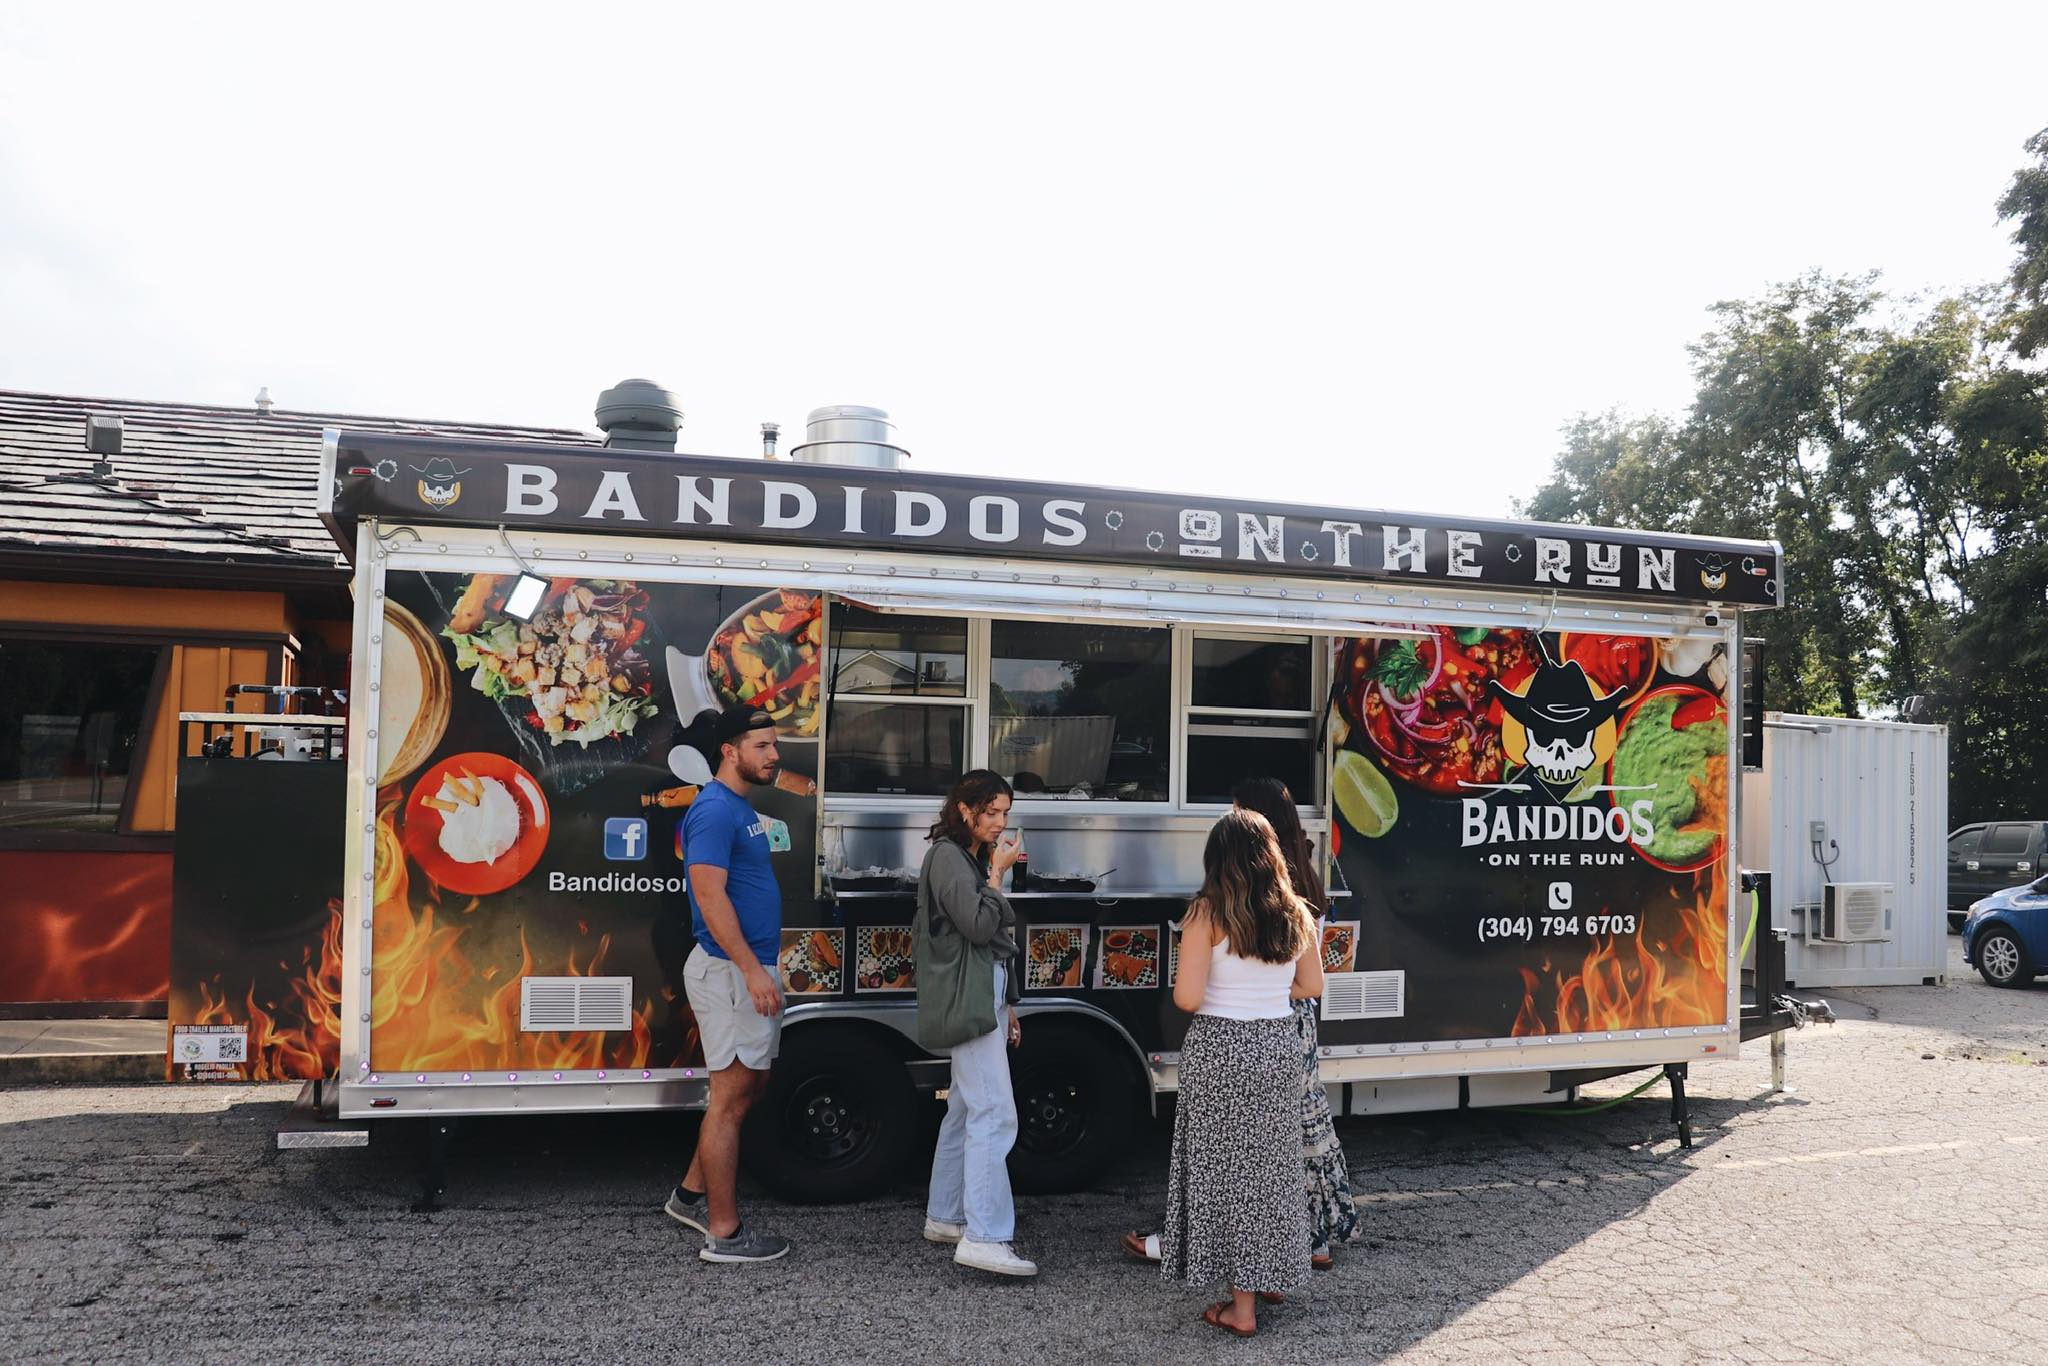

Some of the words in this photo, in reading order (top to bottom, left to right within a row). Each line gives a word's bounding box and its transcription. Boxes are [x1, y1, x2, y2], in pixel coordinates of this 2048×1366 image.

[503, 462, 1089, 547] BANDIDOS
[1178, 507, 1287, 564] ON
[1320, 519, 1485, 578] THE
[1534, 537, 1677, 592] RUN
[1460, 798, 1655, 848] BANDIDOS
[1488, 853, 1520, 866] ON
[1529, 853, 1572, 866] THE
[1580, 853, 1625, 865] RUN
[1478, 917, 1534, 942] (304)
[1540, 916, 1579, 936] 794
[1585, 914, 1636, 935] 6703
